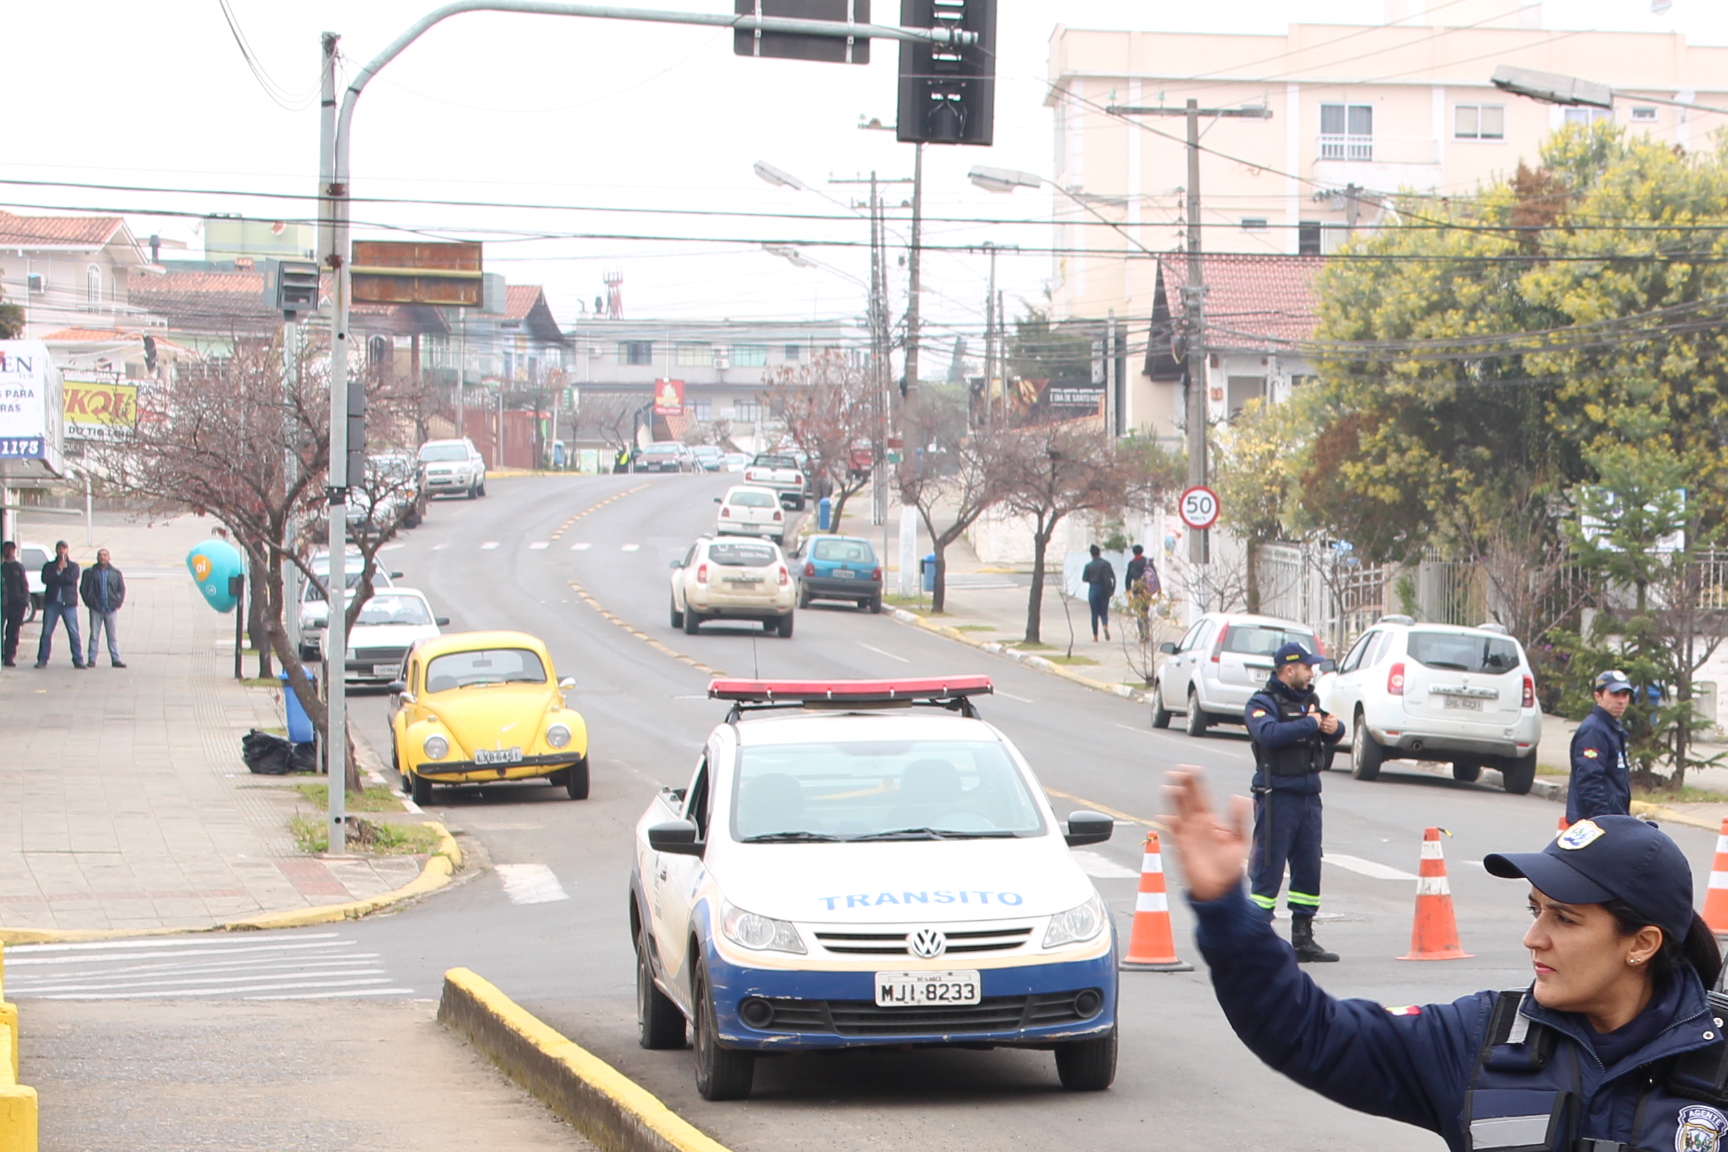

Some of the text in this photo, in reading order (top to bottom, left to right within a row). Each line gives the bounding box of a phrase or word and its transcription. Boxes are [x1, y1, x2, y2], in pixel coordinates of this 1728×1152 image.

[5, 389, 34, 398] PARA
[1186, 496, 1212, 514] 50
[1688, 1109, 1722, 1127] AGENTE
